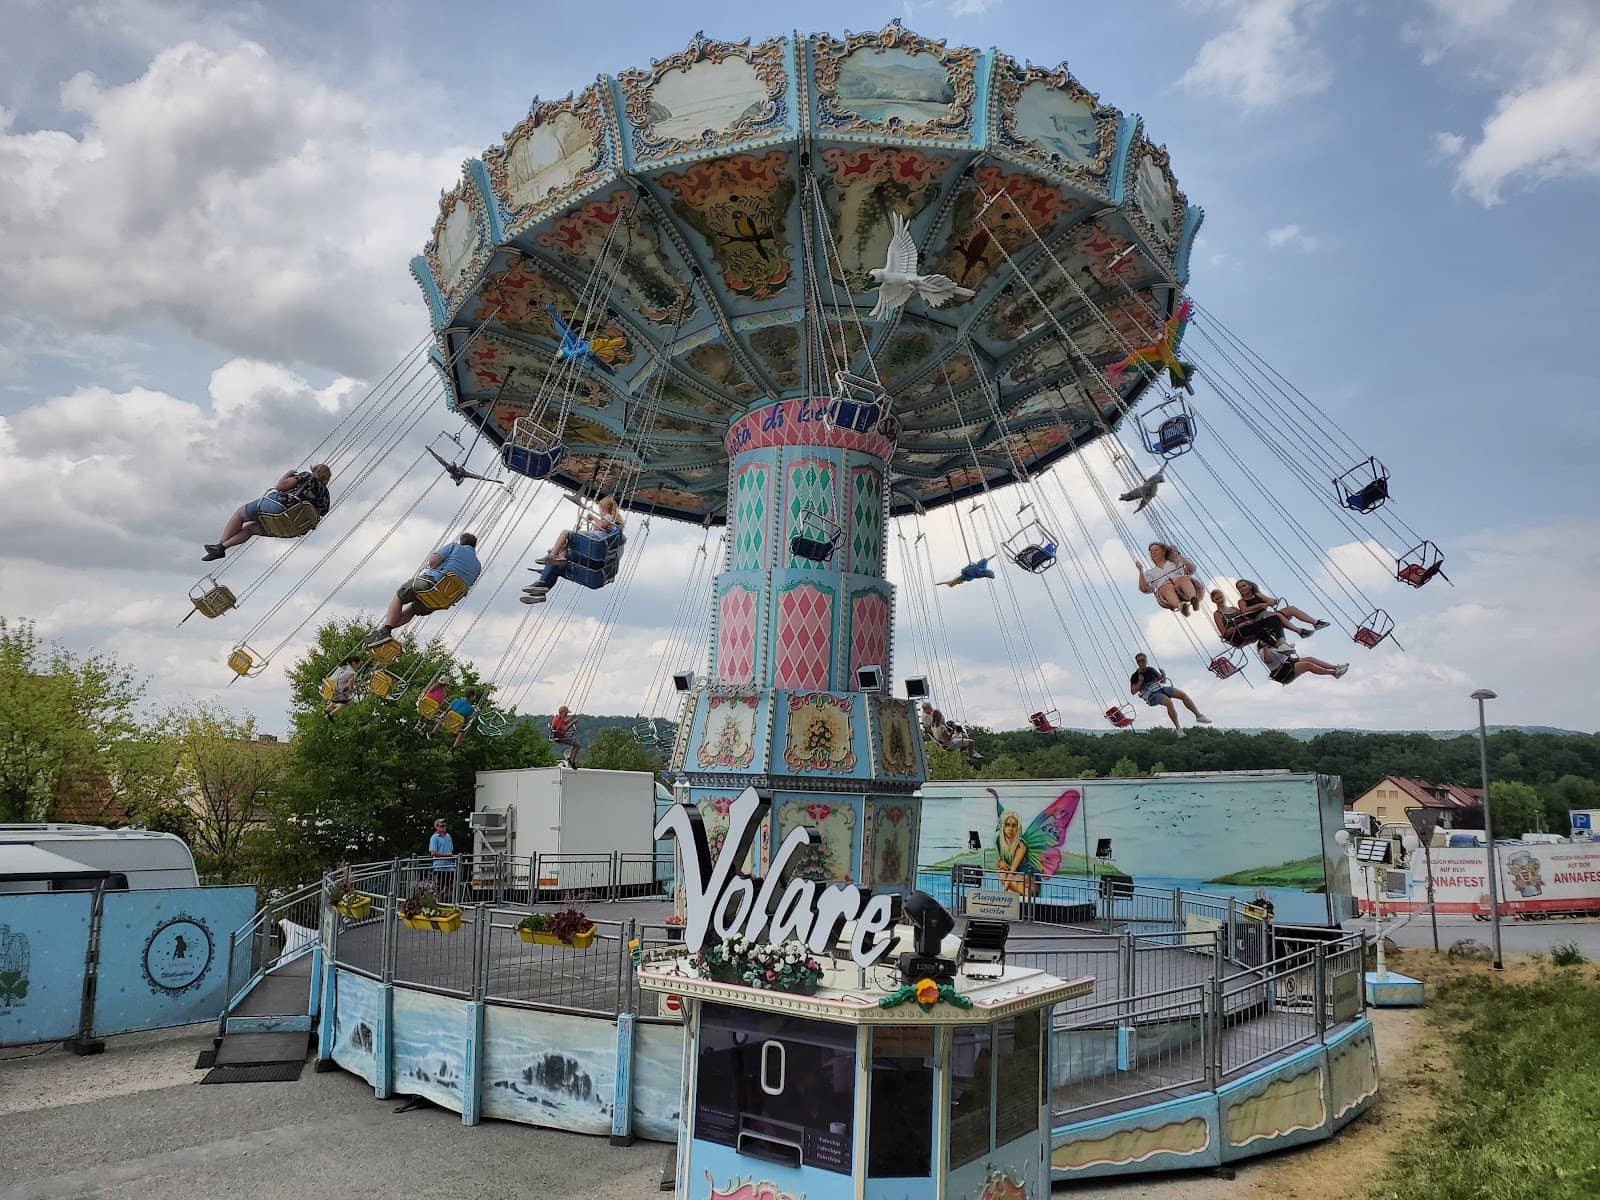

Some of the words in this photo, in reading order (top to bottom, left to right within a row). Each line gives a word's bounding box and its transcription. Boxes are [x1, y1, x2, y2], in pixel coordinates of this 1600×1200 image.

[763, 402, 785, 432] di
[1576, 815, 1586, 827] P
[654, 785, 901, 968] Volare
